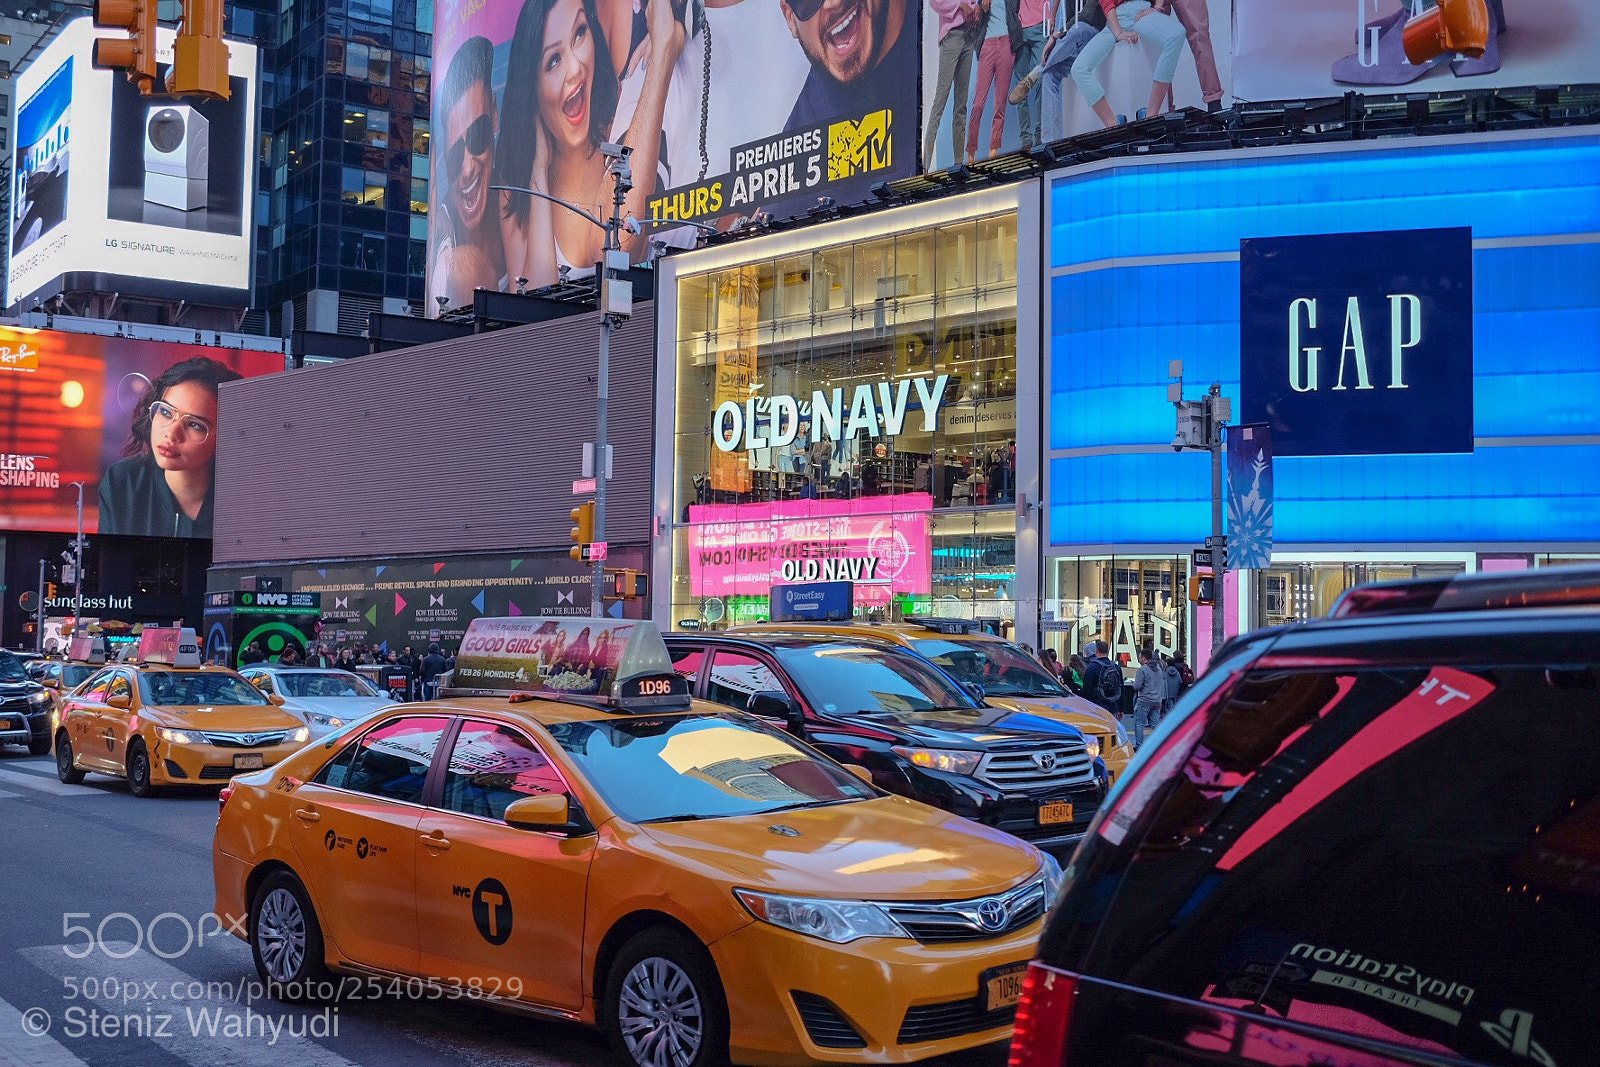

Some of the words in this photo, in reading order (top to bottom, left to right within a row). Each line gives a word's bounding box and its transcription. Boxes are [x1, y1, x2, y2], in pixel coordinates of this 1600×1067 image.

[736, 129, 821, 171] PREMIERES
[828, 109, 892, 182] MTV
[650, 182, 722, 227] THURS
[730, 161, 800, 208] APRIL
[806, 154, 821, 187] 5
[105, 238, 118, 248] LG
[121, 240, 175, 254] SIGNATURE
[1289, 294, 1421, 392] GAP
[0, 344, 36, 364] Ray-Ban
[713, 394, 800, 452] OLD
[811, 374, 951, 443] NAVY
[950, 413, 974, 425] denim
[977, 411, 1011, 422] deserves
[0, 453, 34, 471] LENS
[0, 470, 59, 488] SHAPING
[781, 559, 819, 581] OLD
[822, 557, 878, 580] NAVY
[342, 583, 364, 591] SIGNAGE
[375, 582, 393, 590] PRIME
[394, 581, 415, 589] RETAIL
[416, 580, 436, 589] SPACE
[450, 578, 484, 588] BRANDING
[484, 577, 533, 586] OPPORTUNITY
[545, 576, 570, 585] WORLD
[571, 575, 592, 584] CLASS
[44, 594, 106, 612] sunglass
[109, 595, 133, 609] hut
[257, 593, 288, 606] NYC
[794, 591, 825, 600] StreetEasy
[541, 607, 553, 615] BOW
[554, 607, 562, 615] TIE
[563, 607, 590, 615] BUILDING
[465, 637, 505, 652] GOOD
[505, 638, 542, 654] GIRLS
[1070, 610, 1178, 669] GAP
[460, 668, 472, 676] FEB
[484, 670, 515, 679] MONDAYS
[516, 667, 524, 679] 4
[638, 680, 671, 695] 1D96
[452, 885, 471, 899] NYC
[481, 891, 502, 937] T
[998, 976, 1021, 999] 1D96
